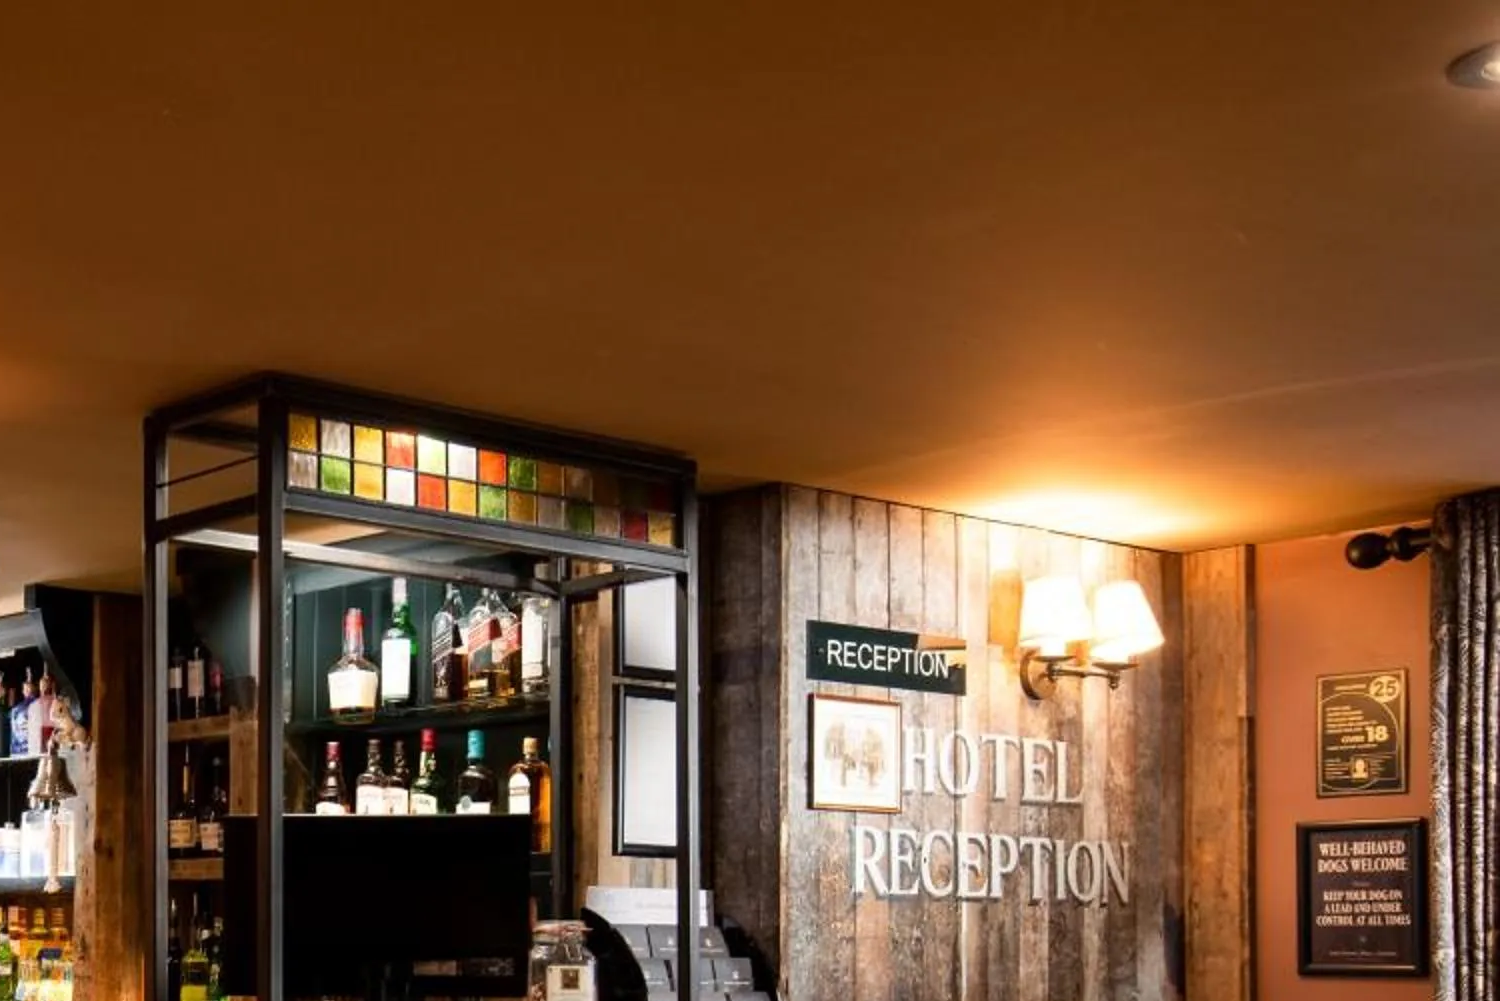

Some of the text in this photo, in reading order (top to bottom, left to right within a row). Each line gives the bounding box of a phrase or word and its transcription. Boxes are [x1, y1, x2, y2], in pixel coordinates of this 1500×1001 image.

[827, 639, 949, 679] RECEPTION
[1374, 680, 1397, 697] 25
[1365, 725, 1389, 742] 18
[902, 726, 1085, 805] HOTEL
[1318, 840, 1406, 857] WELL-BEHAVED
[852, 824, 1130, 906] RECEPTION
[1317, 857, 1408, 873] DOGS WELCOME
[1323, 890, 1345, 902] KEEP
[1369, 889, 1388, 901] DOG
[1324, 902, 1403, 914] A LEAD AND UNDER
[1315, 914, 1412, 927] CONTROL AT ALL TIMES
